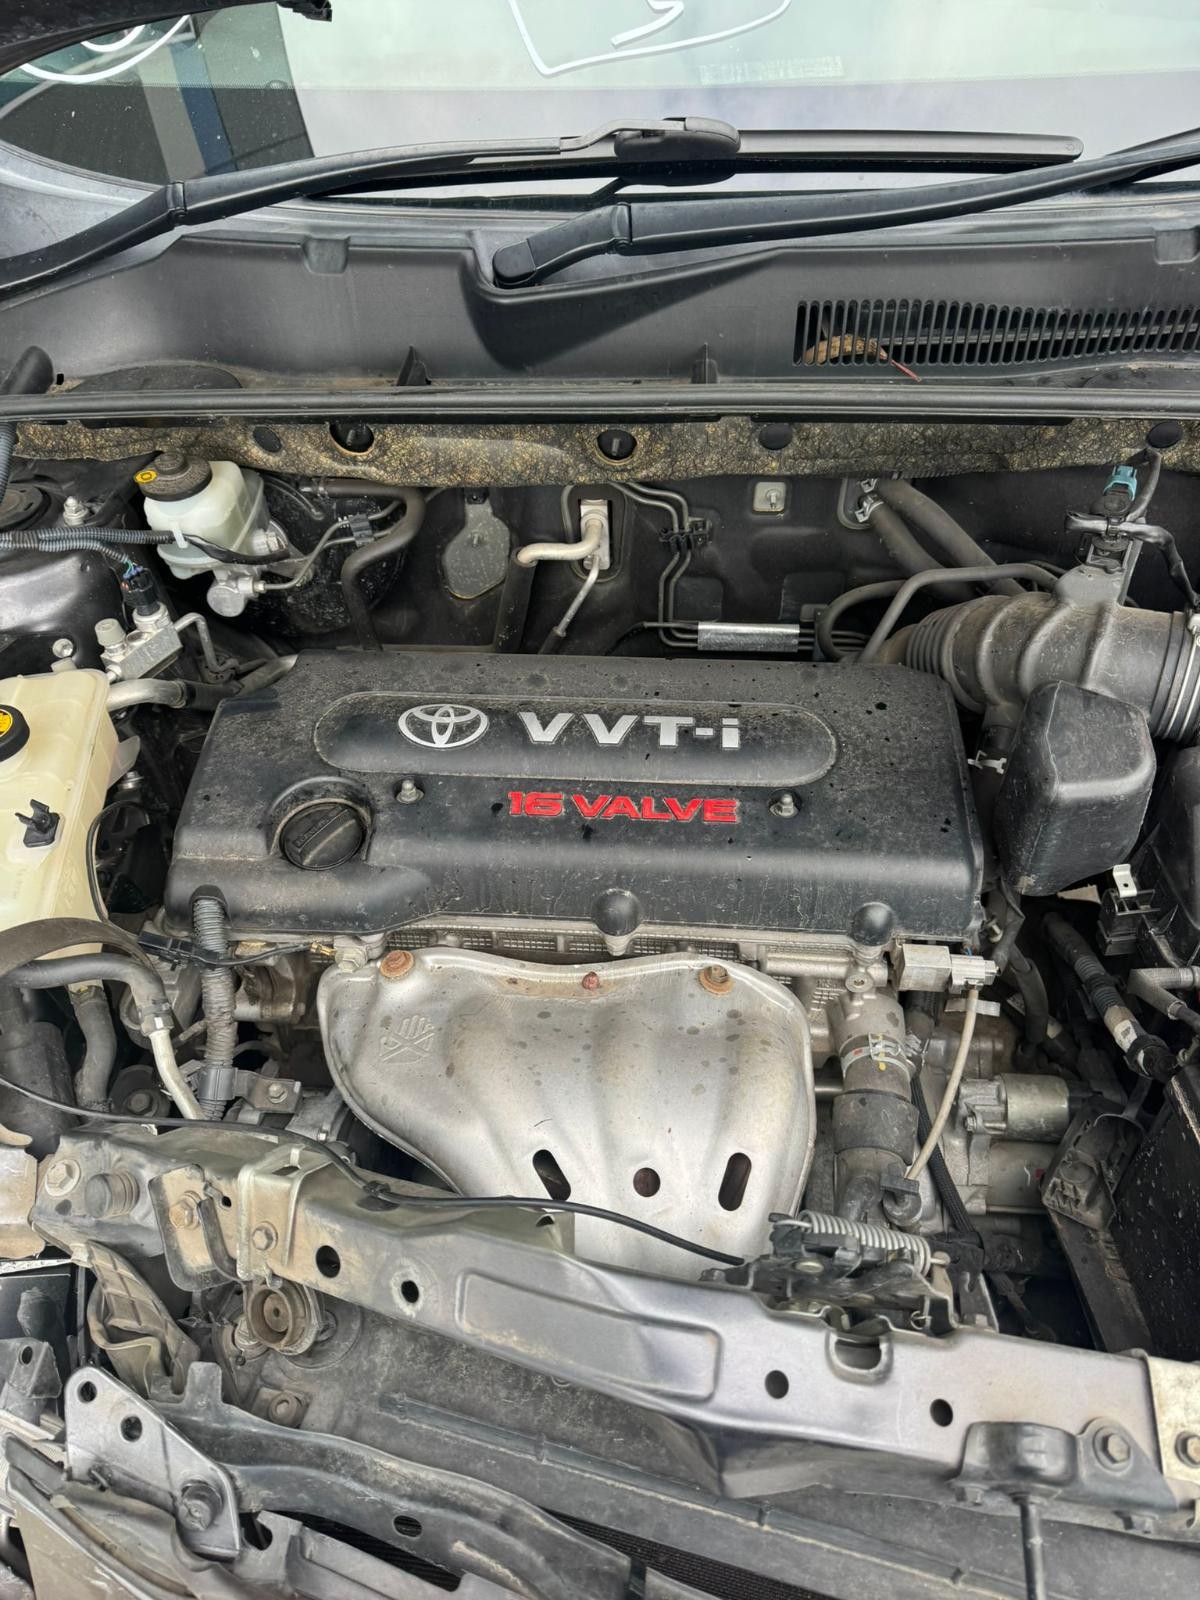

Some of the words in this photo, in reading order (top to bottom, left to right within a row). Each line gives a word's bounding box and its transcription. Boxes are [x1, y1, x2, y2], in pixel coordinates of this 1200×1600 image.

[518, 711, 739, 749] VVT-i
[508, 791, 564, 816] 16
[571, 794, 739, 823] VALVE
